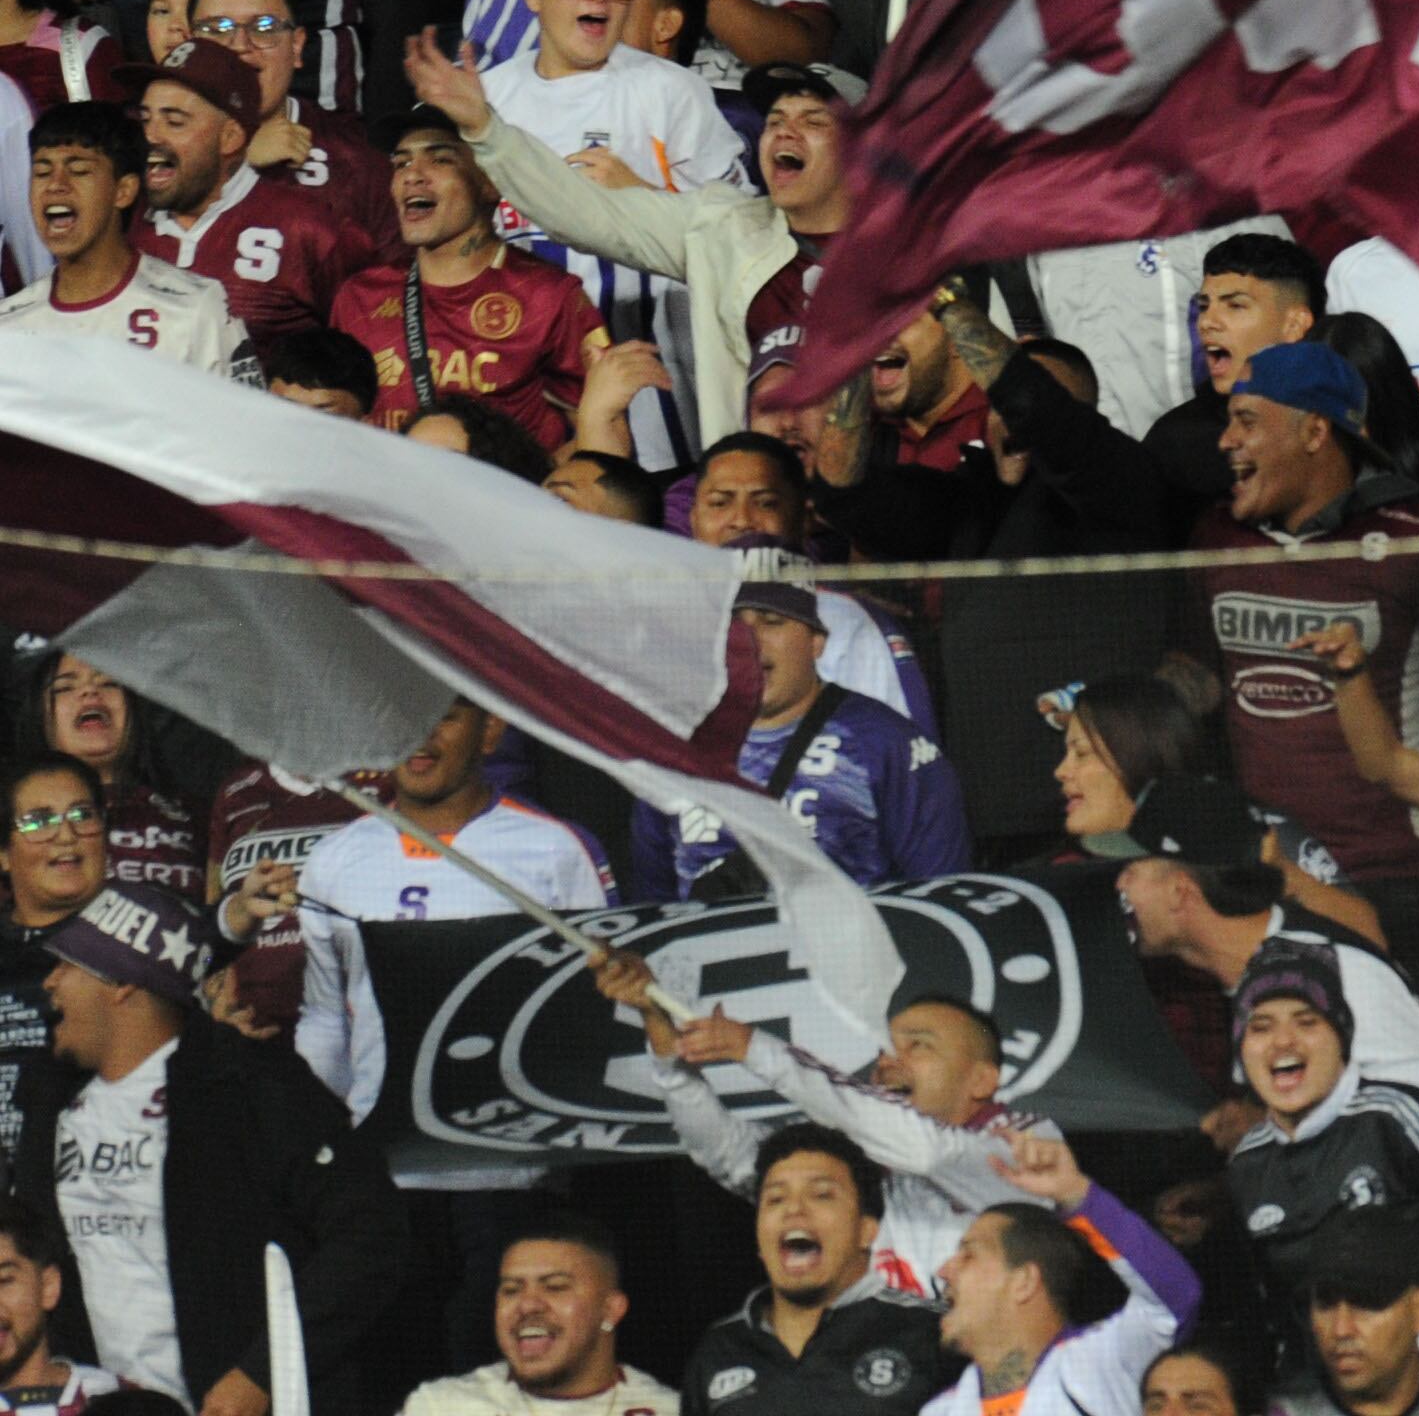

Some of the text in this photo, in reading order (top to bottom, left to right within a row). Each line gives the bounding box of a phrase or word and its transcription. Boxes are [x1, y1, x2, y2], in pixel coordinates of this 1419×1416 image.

[234, 226, 284, 283] S
[129, 307, 160, 348] S
[404, 286, 424, 360] ARMOUR
[799, 735, 841, 777] S
[91, 1135, 153, 1177] BAC
[868, 1358, 894, 1385] S
